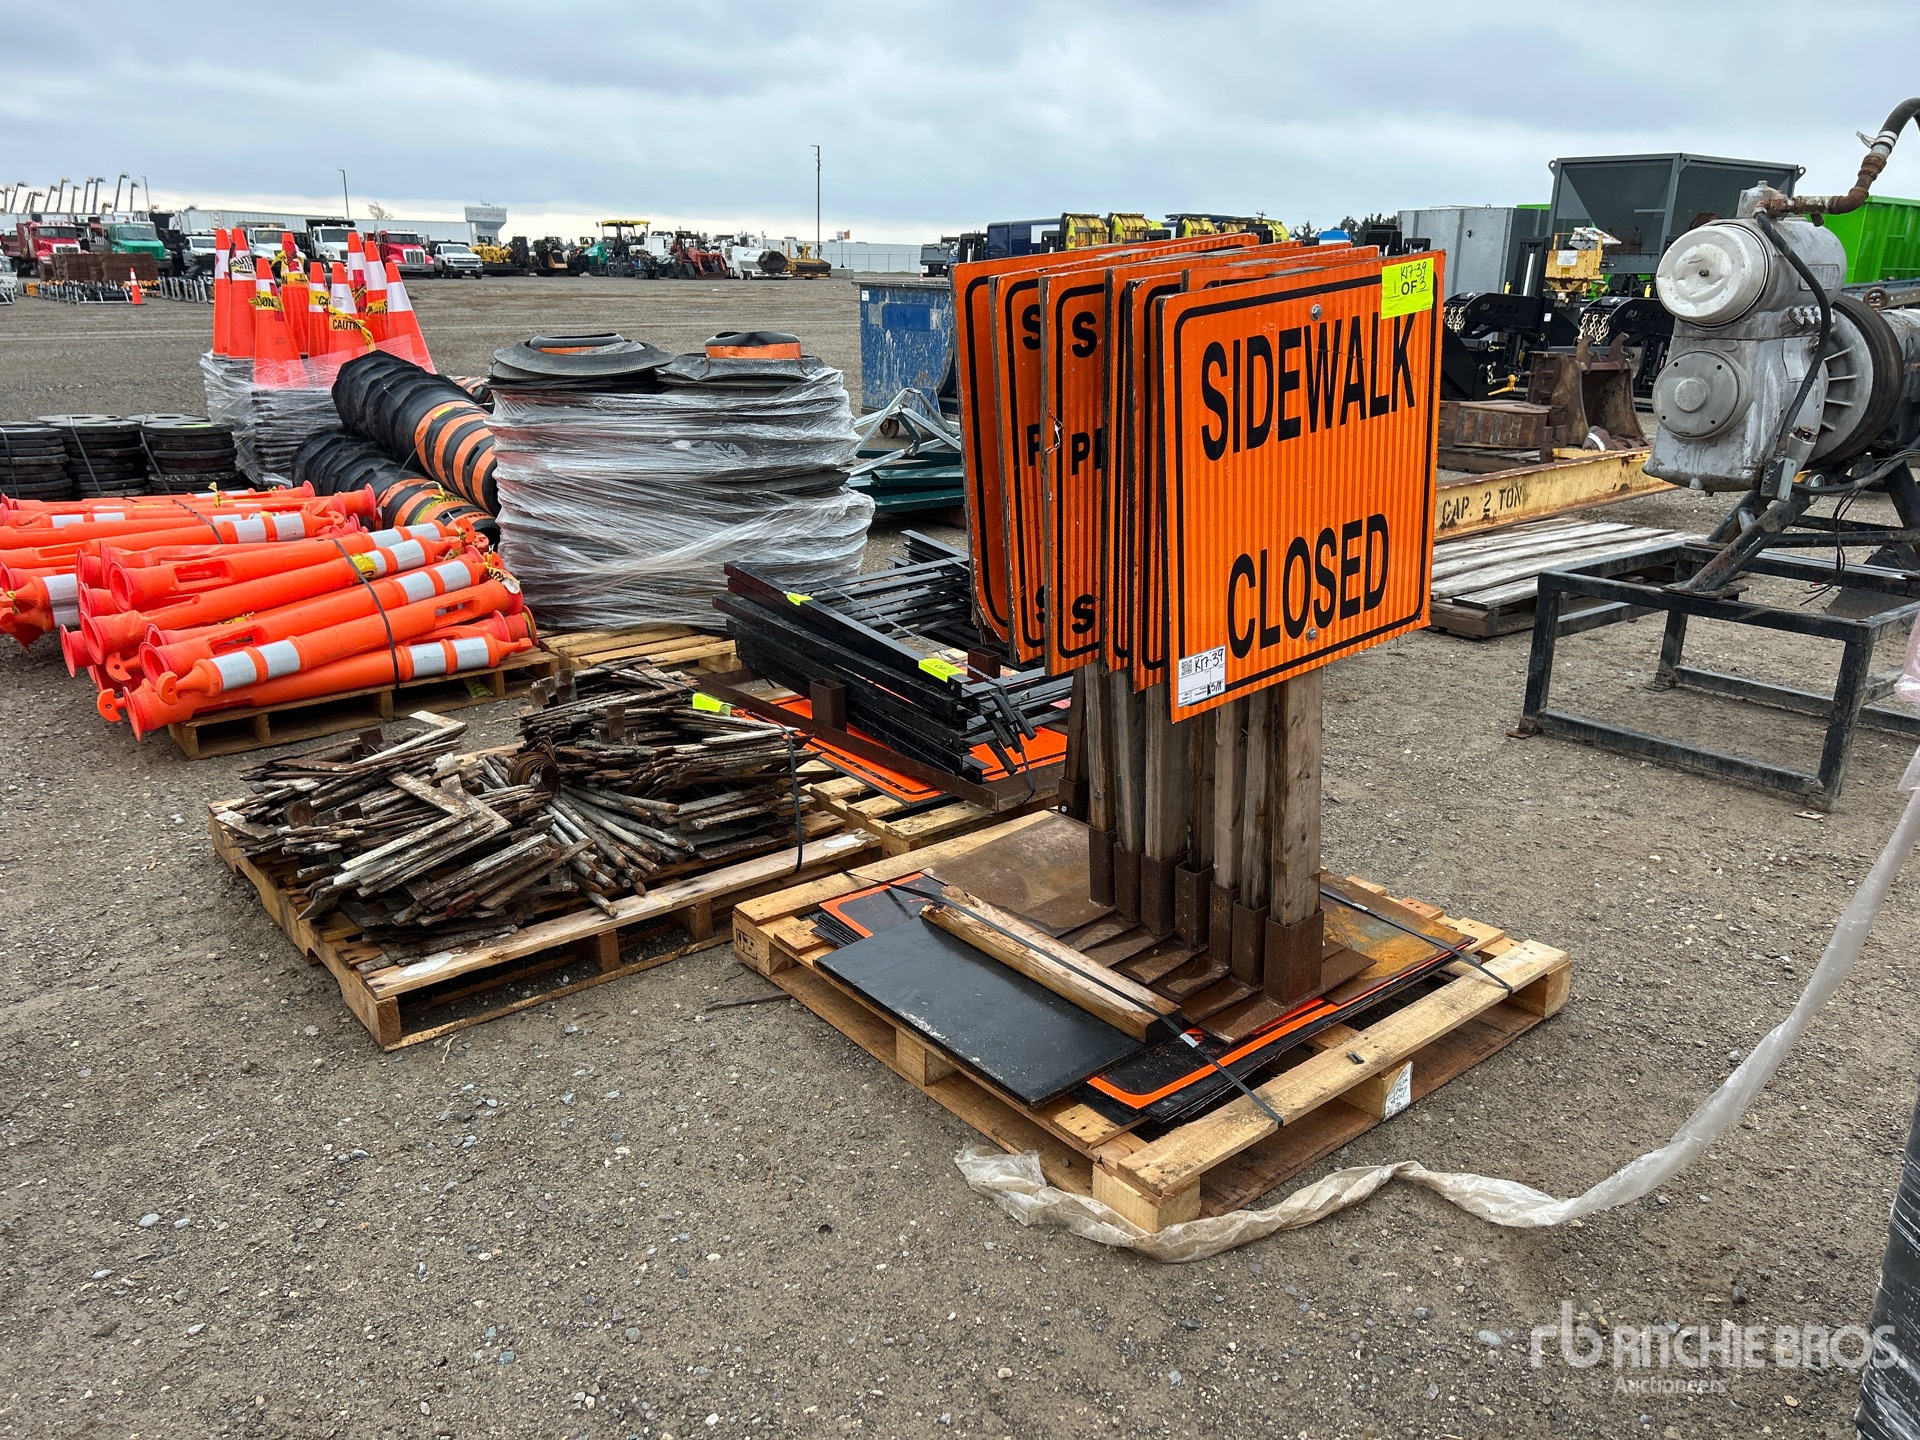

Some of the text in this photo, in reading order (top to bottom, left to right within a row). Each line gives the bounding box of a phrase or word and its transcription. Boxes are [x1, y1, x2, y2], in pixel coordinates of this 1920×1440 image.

[1401, 280, 1418, 295] OF
[1201, 311, 1416, 462] SIDEWALK
[1482, 490, 1492, 514] 2
[1498, 485, 1523, 511] TON
[1227, 513, 1390, 660] CLOSED
